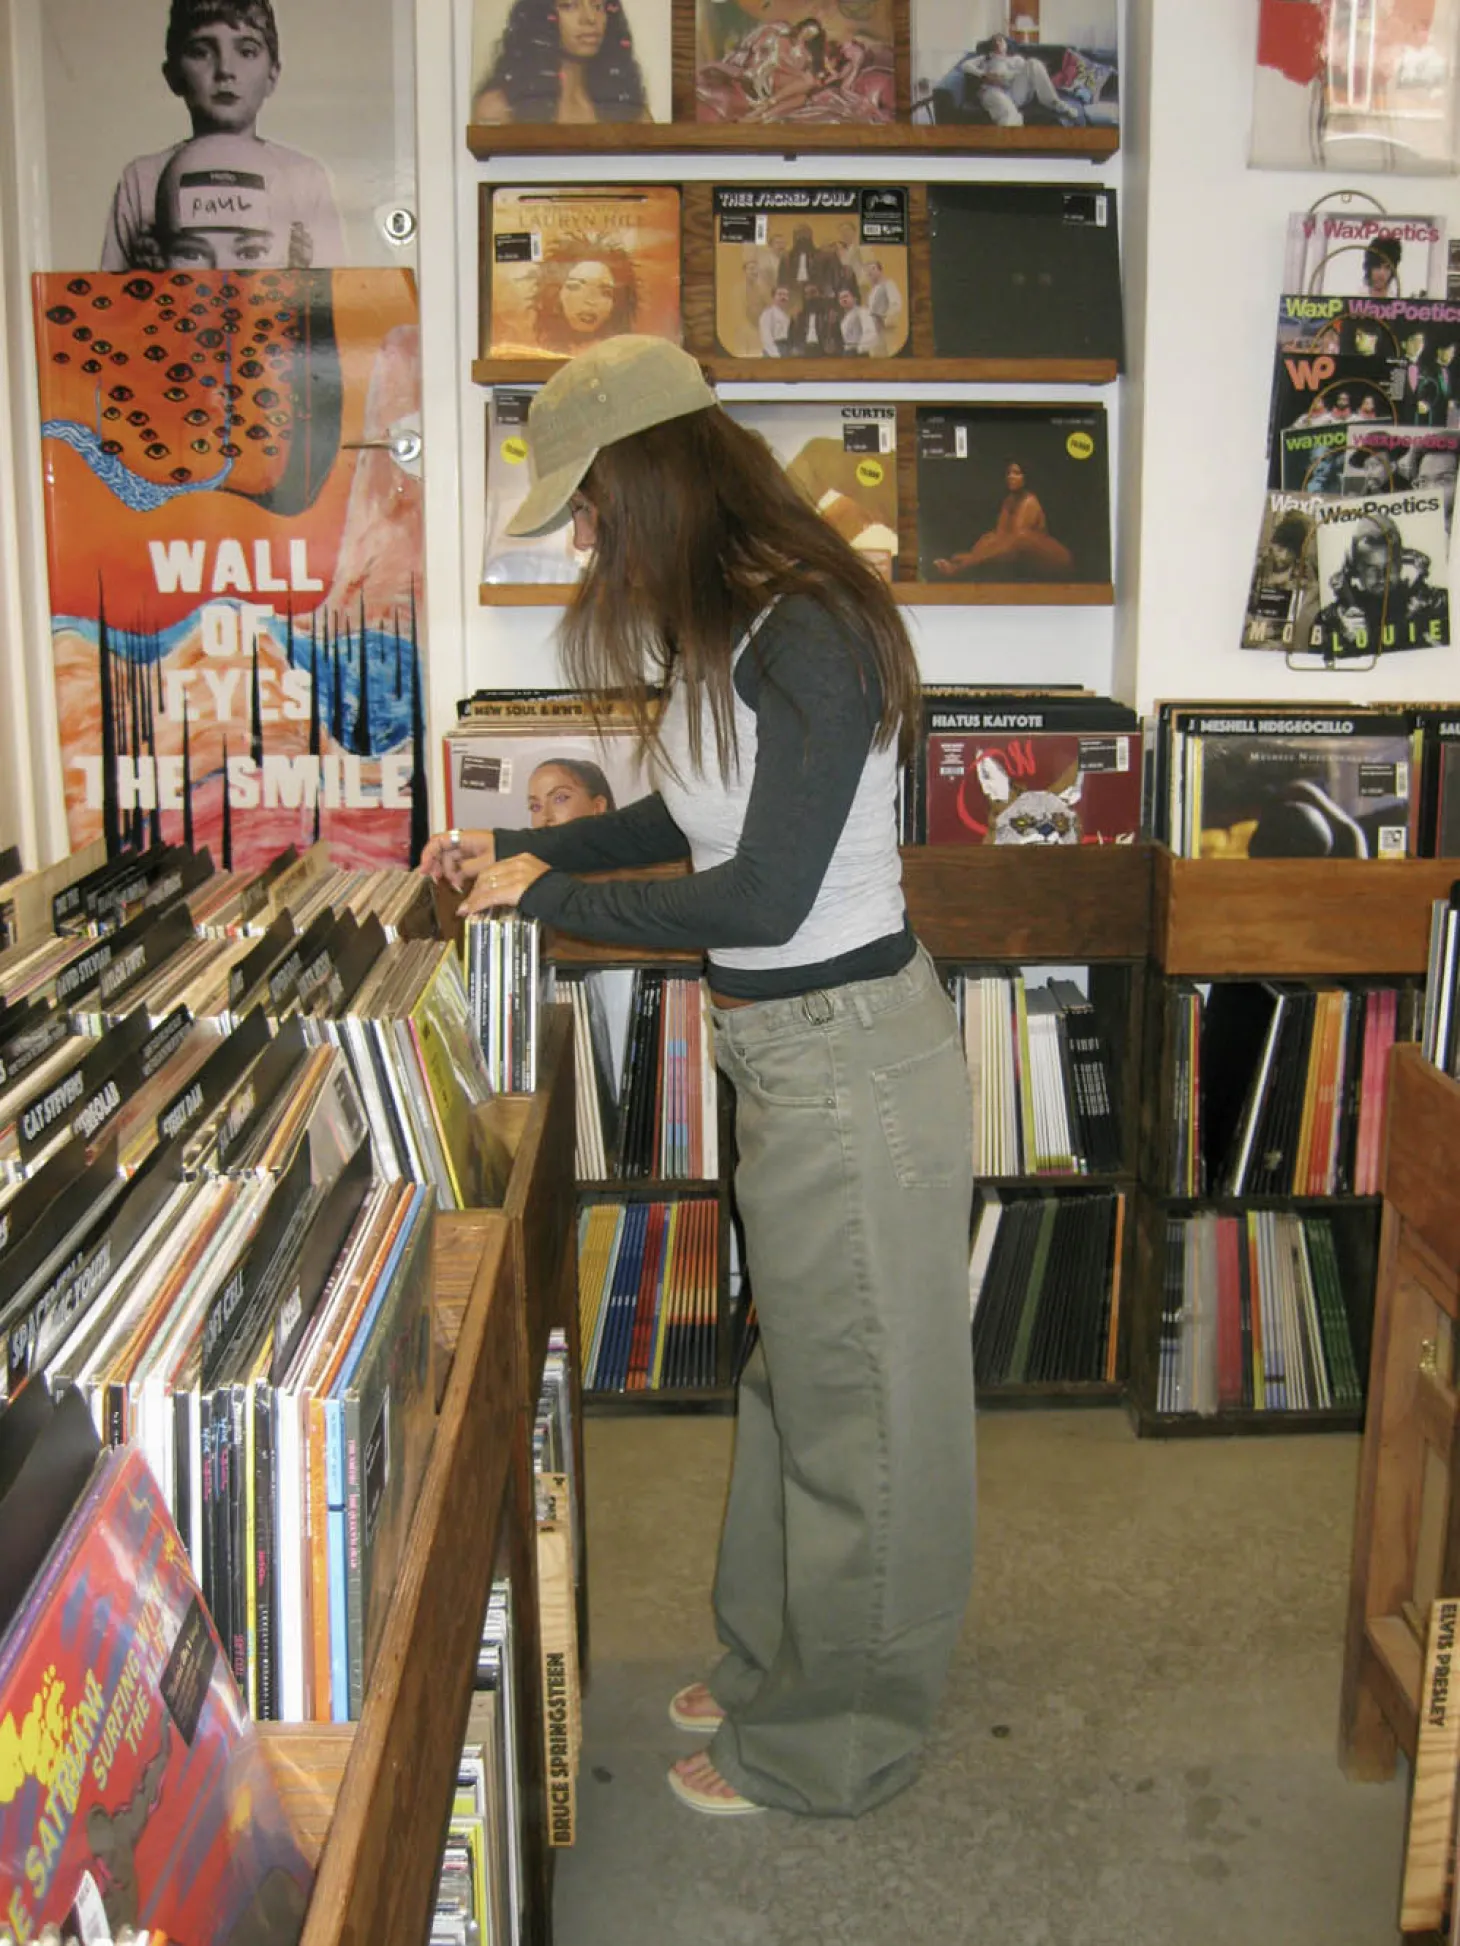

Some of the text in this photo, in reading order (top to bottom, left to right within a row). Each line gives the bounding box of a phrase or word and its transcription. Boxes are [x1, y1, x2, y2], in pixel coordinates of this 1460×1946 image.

[1323, 219, 1440, 242] WaxPoetics
[840, 406, 895, 418] CURTIS
[1319, 495, 1440, 525] WaxPoetics
[148, 539, 324, 594] WALL
[198, 604, 276, 657] OF
[167, 669, 311, 722] EYES
[932, 714, 1044, 727] HIATUS KAIYOTE
[1200, 719, 1256, 733] MESHELL
[72, 754, 184, 810] THE
[226, 754, 414, 810] SMILE
[1428, 1603, 1458, 1727] ELVIS PRESLEY
[92, 1647, 140, 1792] SURFING
[124, 1684, 150, 1756] THE
[545, 1652, 573, 1847] BRUCE SPRINGSTEEN
